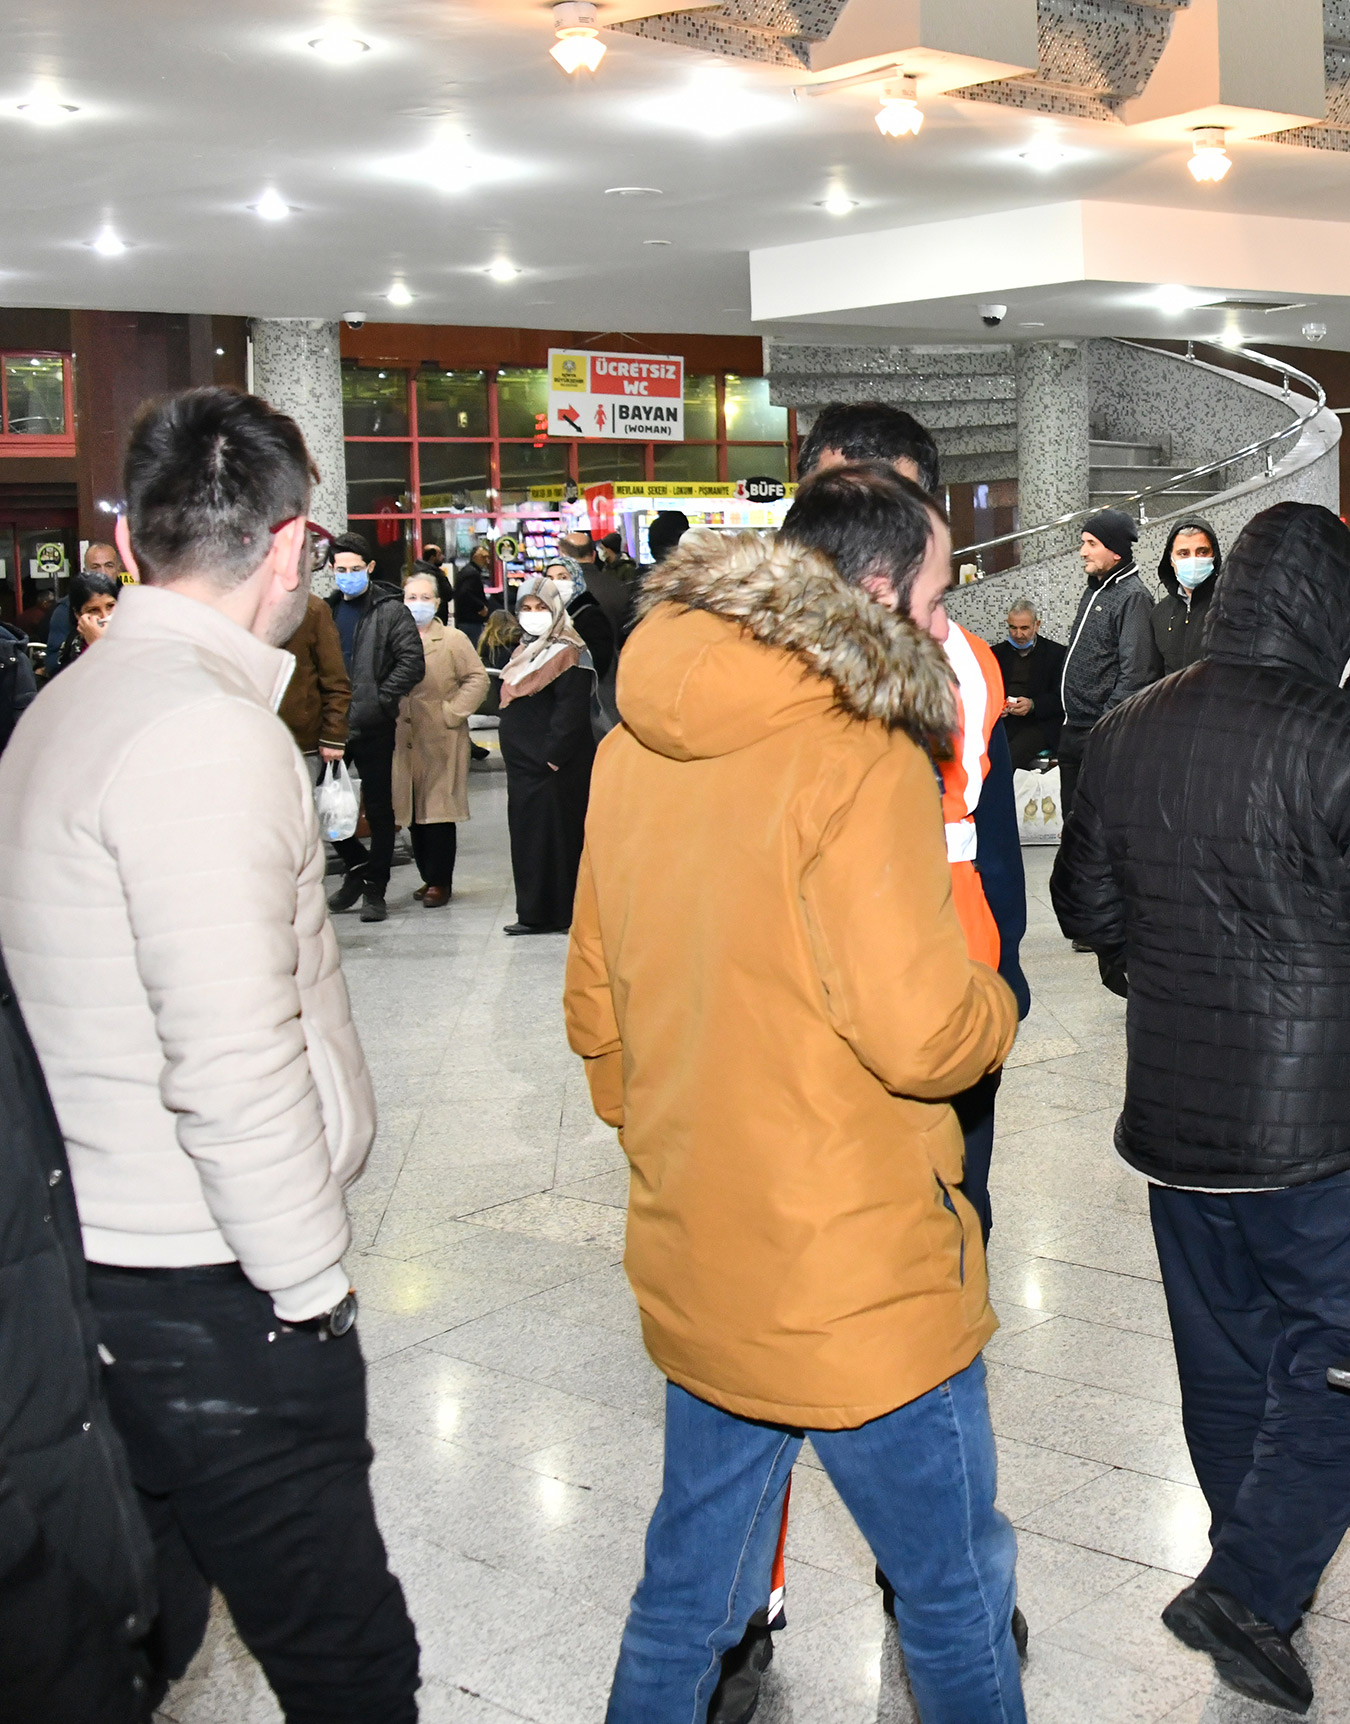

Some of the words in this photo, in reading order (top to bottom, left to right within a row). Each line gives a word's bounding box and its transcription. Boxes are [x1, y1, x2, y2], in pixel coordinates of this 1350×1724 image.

[623, 380, 649, 396] WC
[618, 404, 678, 422] BAYAN
[624, 424, 672, 435] (WOMAN)
[616, 485, 644, 495] MEVLANA
[673, 486, 693, 496] LOKUM
[750, 480, 784, 497] BÜFE
